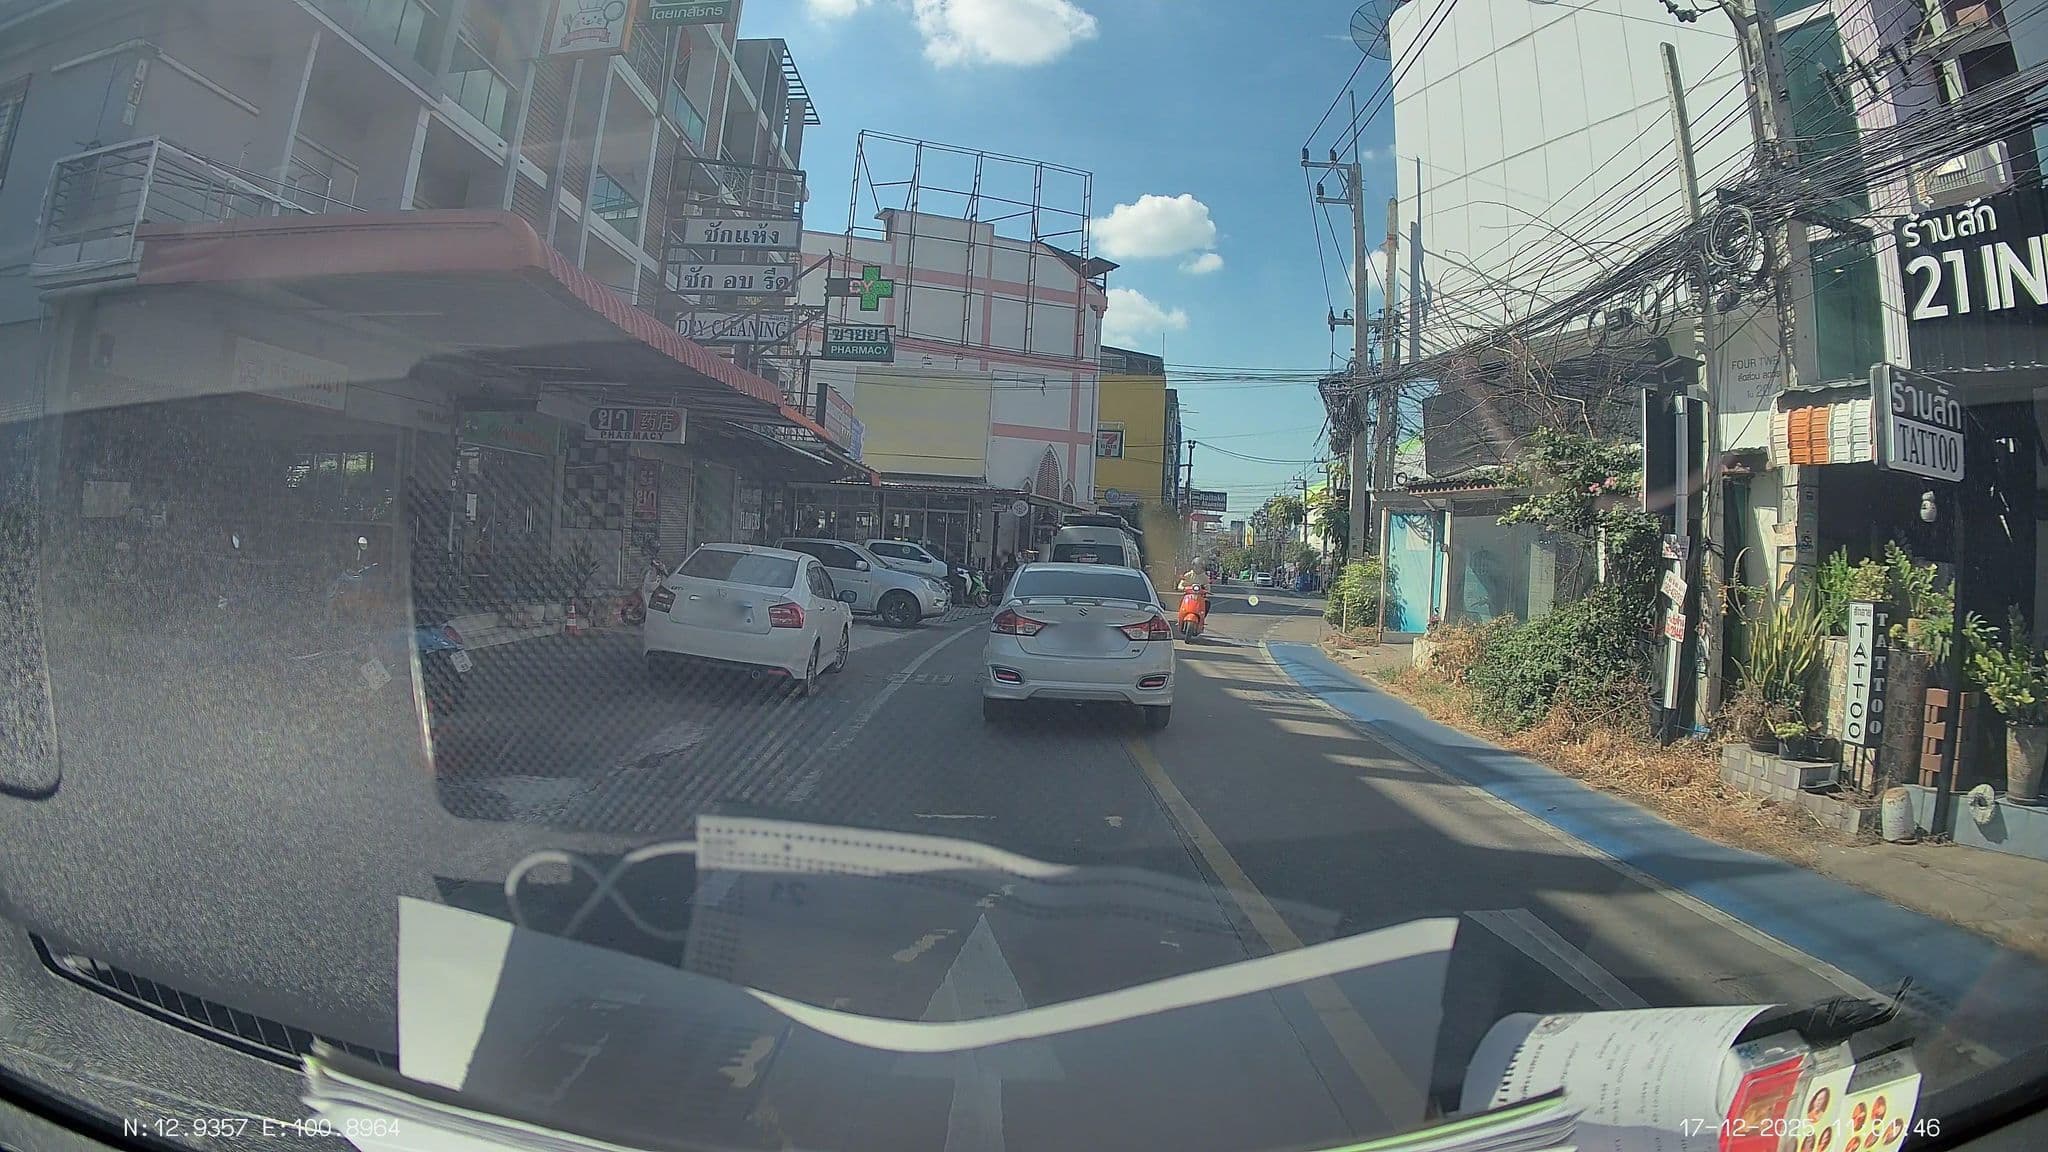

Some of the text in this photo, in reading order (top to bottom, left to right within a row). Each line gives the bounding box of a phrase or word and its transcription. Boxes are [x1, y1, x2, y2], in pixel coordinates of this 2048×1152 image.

[704, 221, 780, 244] ซักแห้ง
[1902, 198, 1998, 248] ร้านสัก
[684, 266, 714, 289] ซัก
[723, 275, 754, 289] อบ
[1905, 233, 2048, 321] 21 IN
[711, 318, 787, 338] CLEANING
[832, 327, 890, 342] ขายยา
[830, 345, 889, 355] PHARMACY
[1731, 358, 1757, 370] FOUR
[1891, 371, 1962, 430] ร้านสัก
[598, 409, 629, 431] ยา
[640, 411, 675, 432] 药店
[600, 431, 665, 441] PHARMACY
[1899, 423, 1959, 474] TATTOO
[1848, 622, 1869, 739] TATTOO
[1869, 612, 1889, 735] TATTOO
